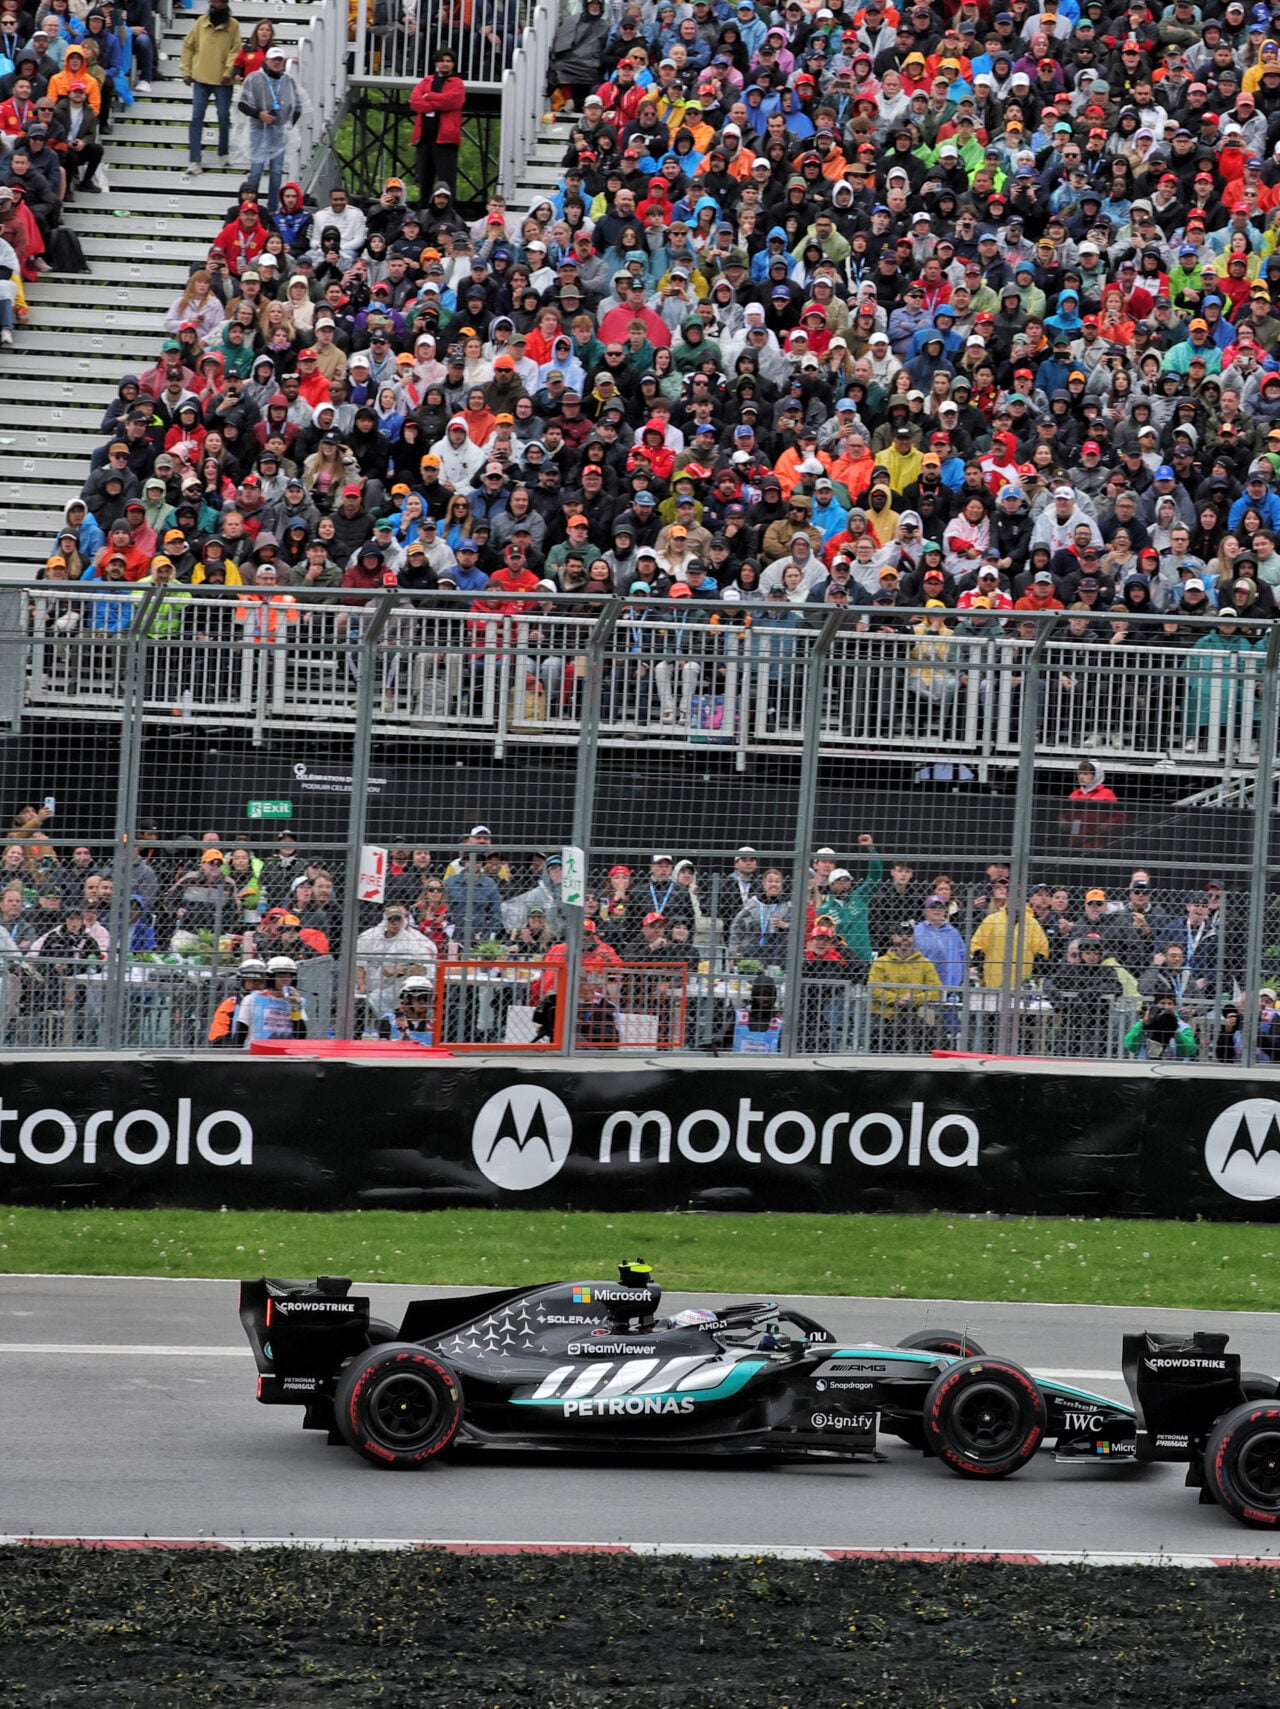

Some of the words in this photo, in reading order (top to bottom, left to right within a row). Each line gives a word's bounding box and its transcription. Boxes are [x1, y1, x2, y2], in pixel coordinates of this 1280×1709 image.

[263, 803, 290, 813] Exit
[360, 873, 383, 888] FIRE
[563, 877, 582, 890] EXIT
[599, 1097, 980, 1168] motorola
[594, 1289, 652, 1302] Microsoft
[280, 1302, 355, 1312] CROWDSTRIKE
[547, 1315, 592, 1325] SOLERA
[698, 1321, 720, 1332] AMD
[580, 1343, 656, 1355] TeamViewer
[848, 1364, 887, 1372] AMG
[1150, 1358, 1226, 1369] CROWDSTRIKE
[829, 1381, 874, 1391] Snapdragon
[563, 1396, 695, 1418] PETRONAS
[1064, 1413, 1104, 1432] IWC
